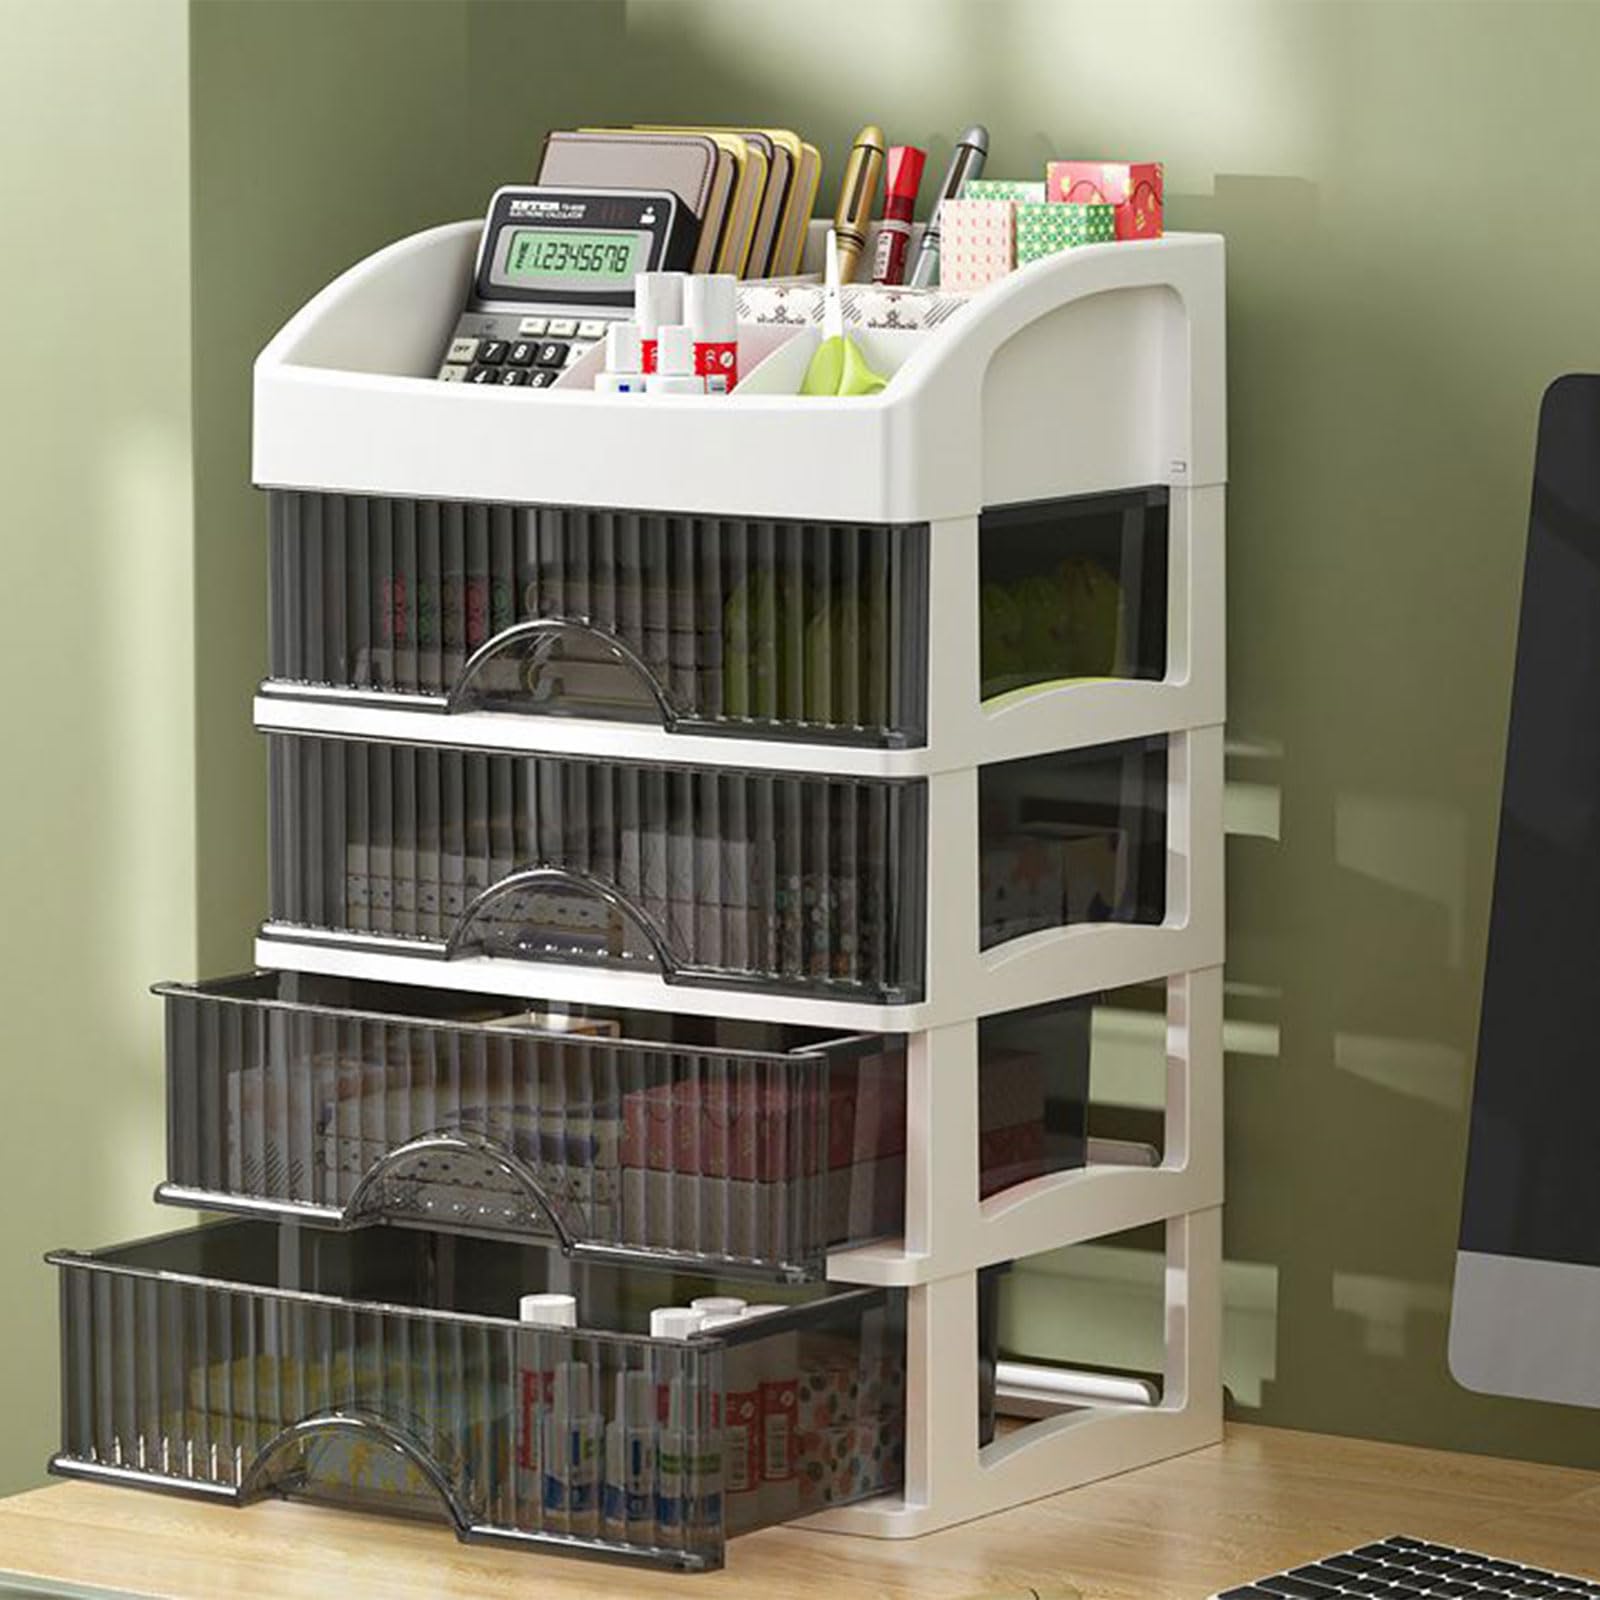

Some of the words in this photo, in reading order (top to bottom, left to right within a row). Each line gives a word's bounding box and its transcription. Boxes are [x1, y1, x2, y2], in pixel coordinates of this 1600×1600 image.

[486, 343, 499, 357] 7
[514, 344, 527, 359] 8
[543, 346, 556, 360] 9
